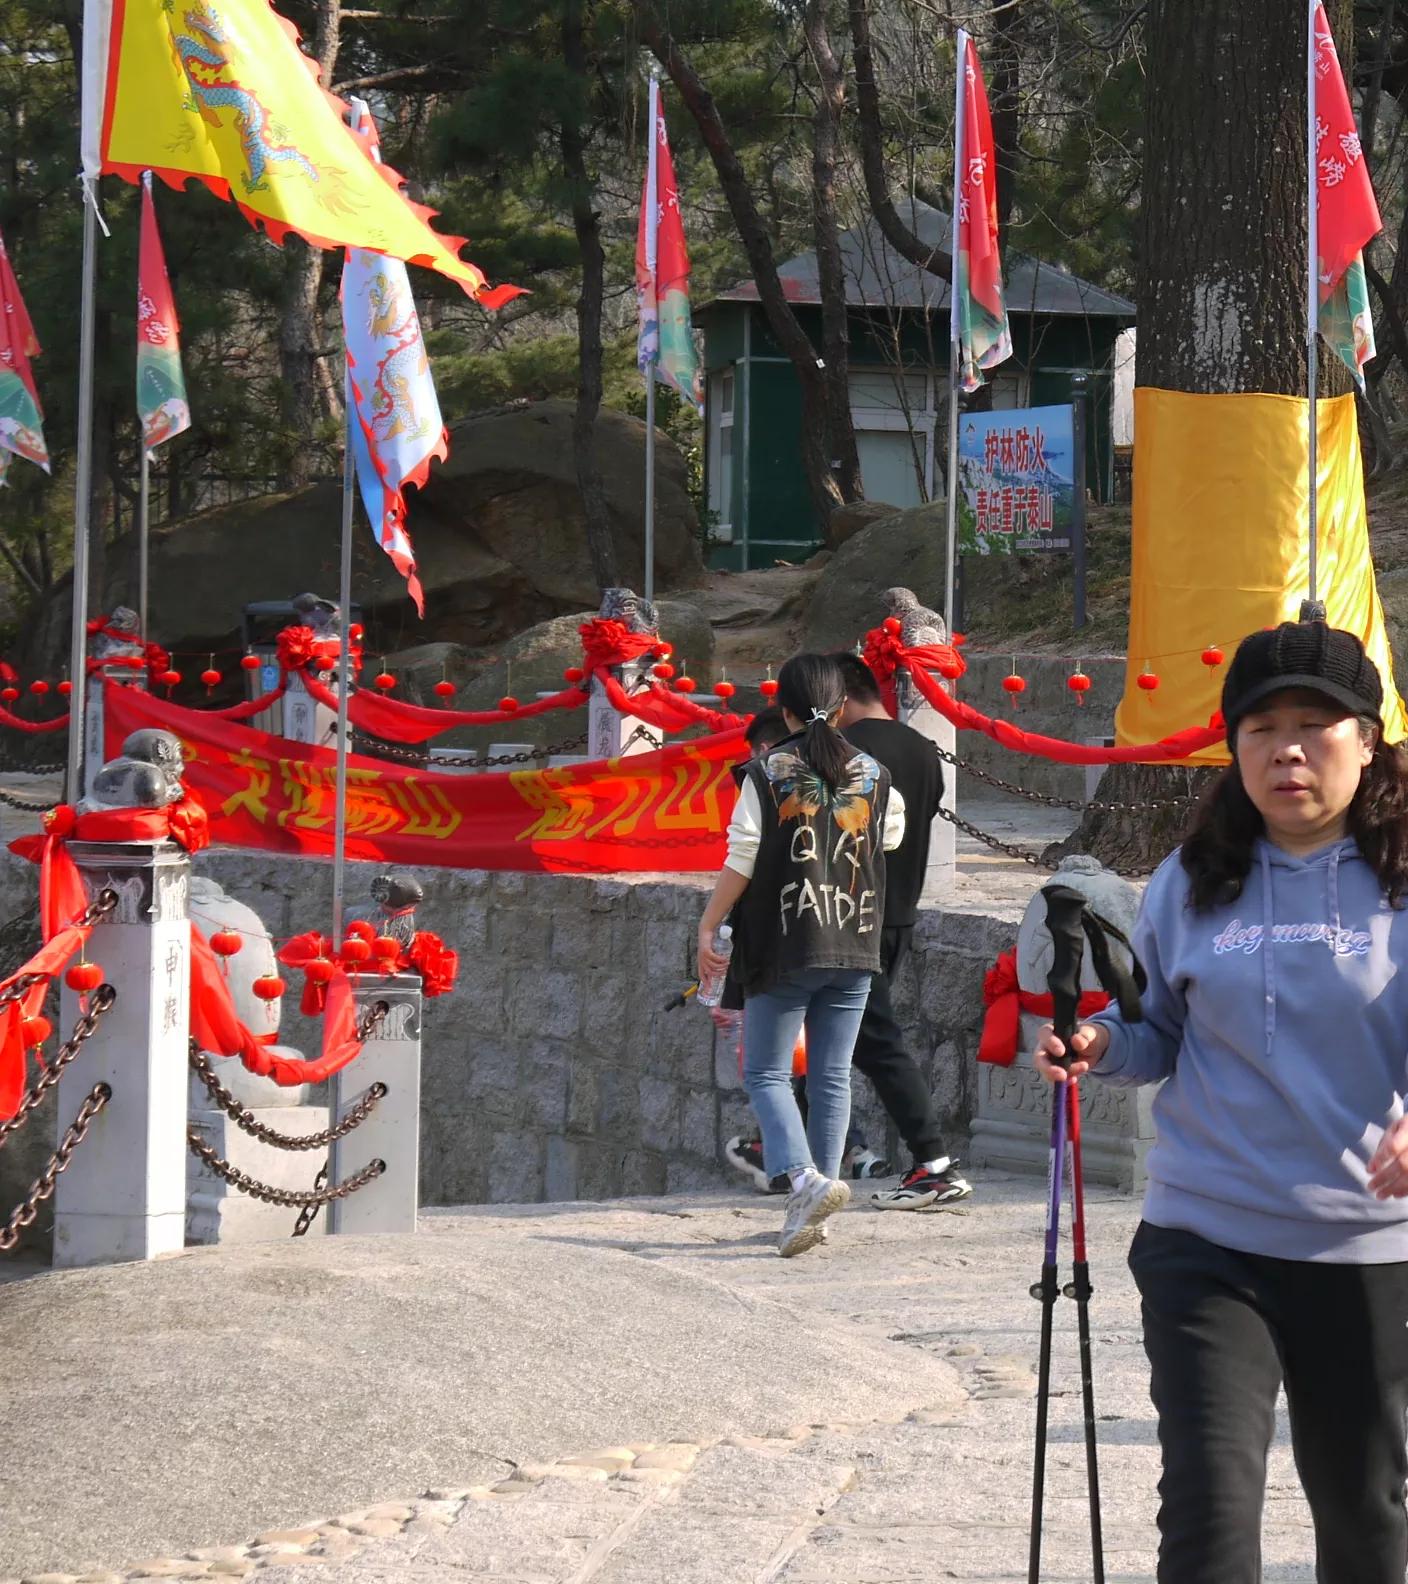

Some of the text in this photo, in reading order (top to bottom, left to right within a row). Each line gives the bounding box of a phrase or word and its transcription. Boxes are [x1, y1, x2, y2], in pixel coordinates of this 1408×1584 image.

[985, 424, 1047, 475] 护林防火
[975, 484, 1054, 535] 责任重于泰山
[509, 745, 741, 841] 魅力山
